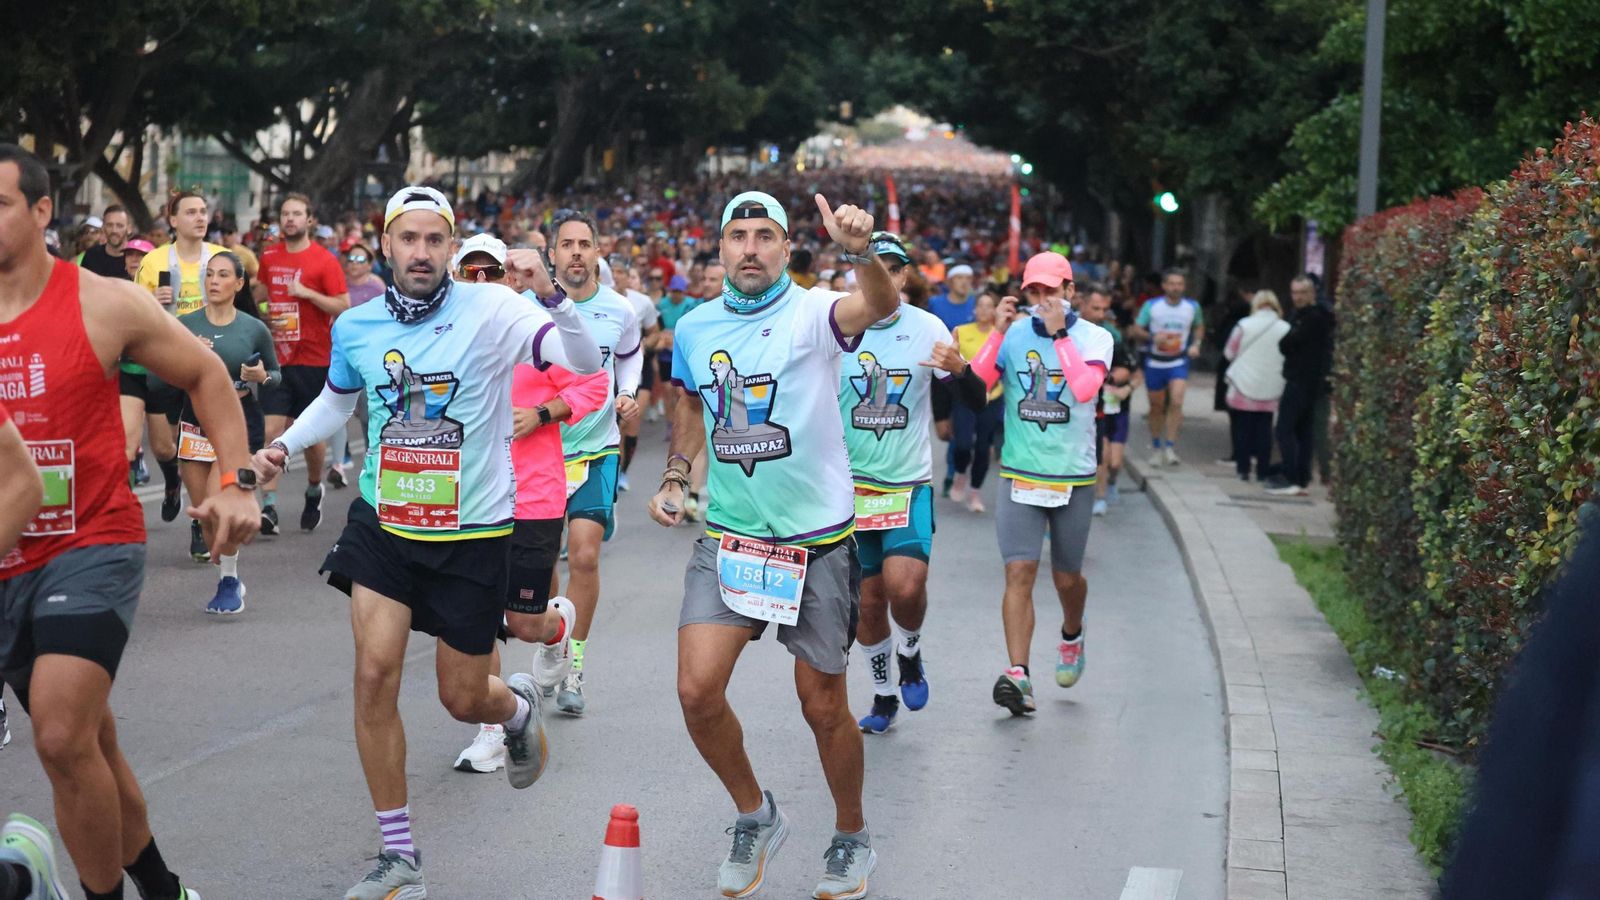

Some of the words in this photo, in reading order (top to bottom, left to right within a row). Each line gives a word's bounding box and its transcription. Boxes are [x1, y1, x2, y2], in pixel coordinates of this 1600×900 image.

[715, 439, 784, 455] #TEAMRAPAZ
[397, 450, 454, 465] GENERALI
[396, 476, 436, 493] 4433
[864, 497, 893, 508] 2994
[735, 565, 784, 587] 15812
